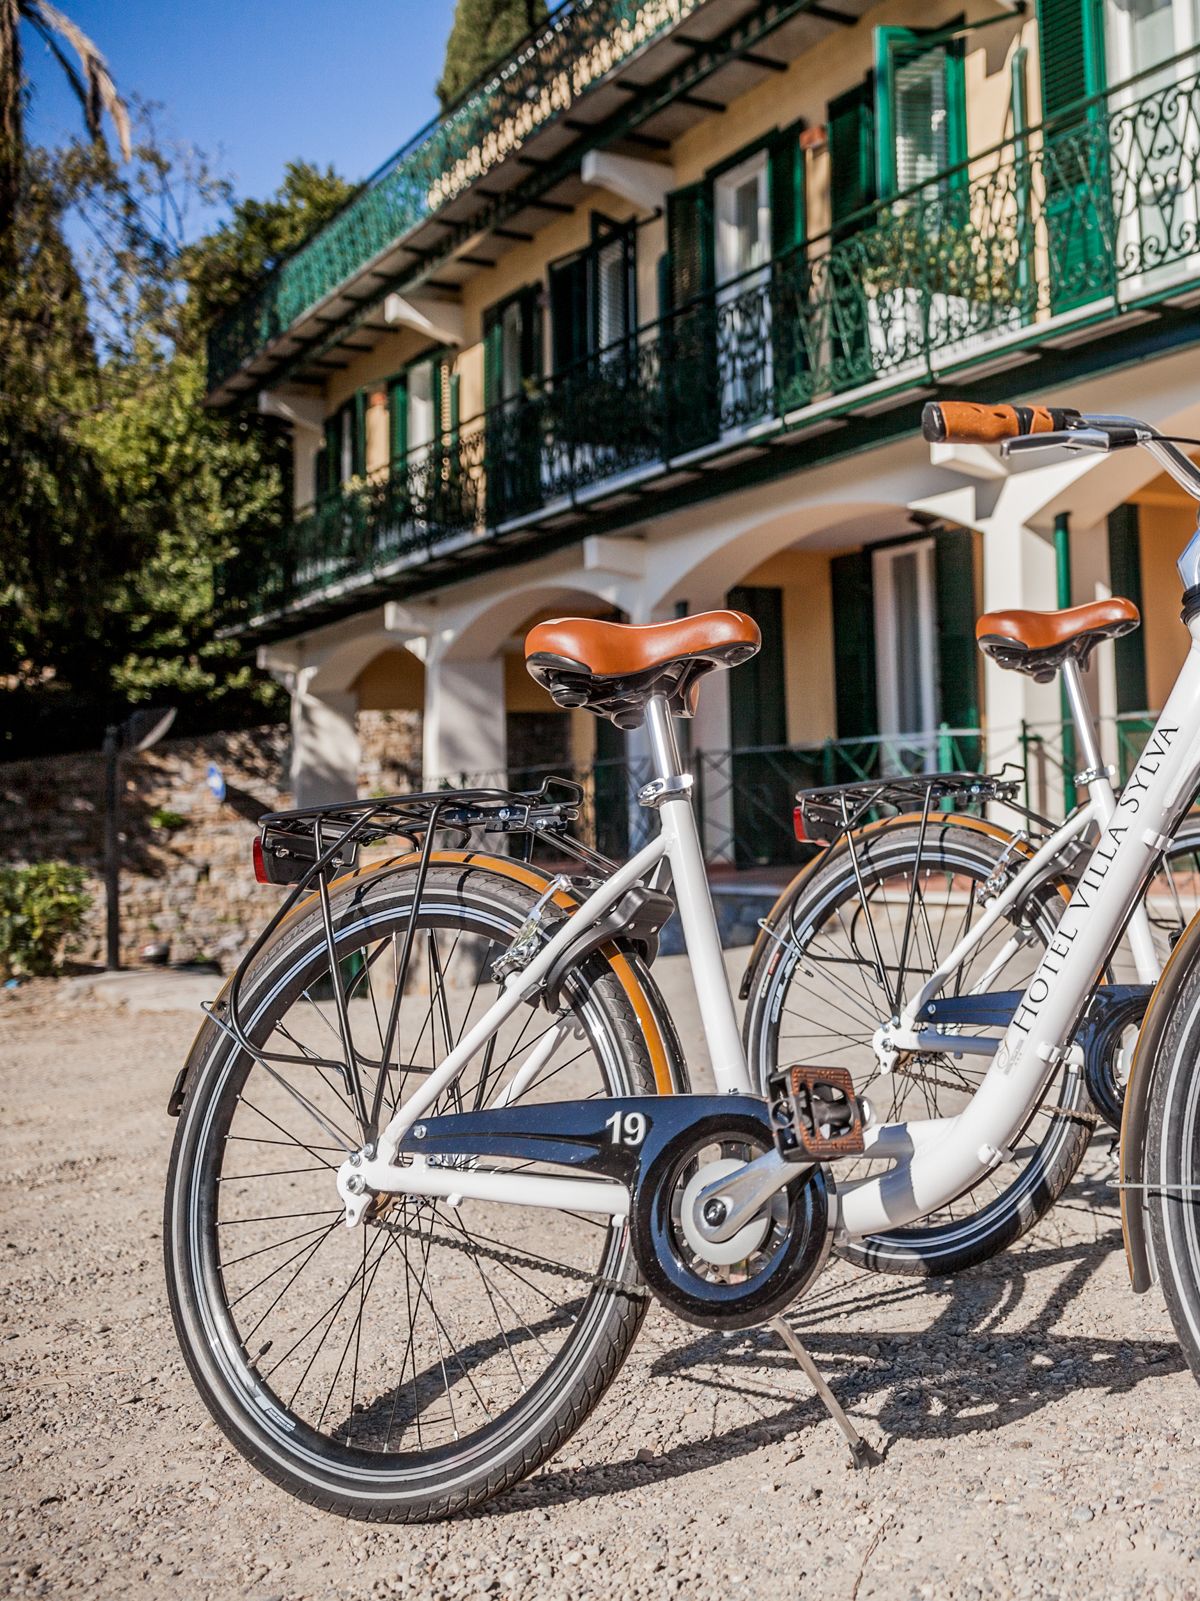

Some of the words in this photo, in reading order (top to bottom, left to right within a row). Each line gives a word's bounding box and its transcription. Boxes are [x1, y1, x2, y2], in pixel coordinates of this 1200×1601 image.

[1012, 927, 1078, 1035] HOTEL
[1069, 824, 1129, 912] VILLA
[1120, 724, 1179, 814] SYLVA
[605, 1110, 646, 1146] 19
